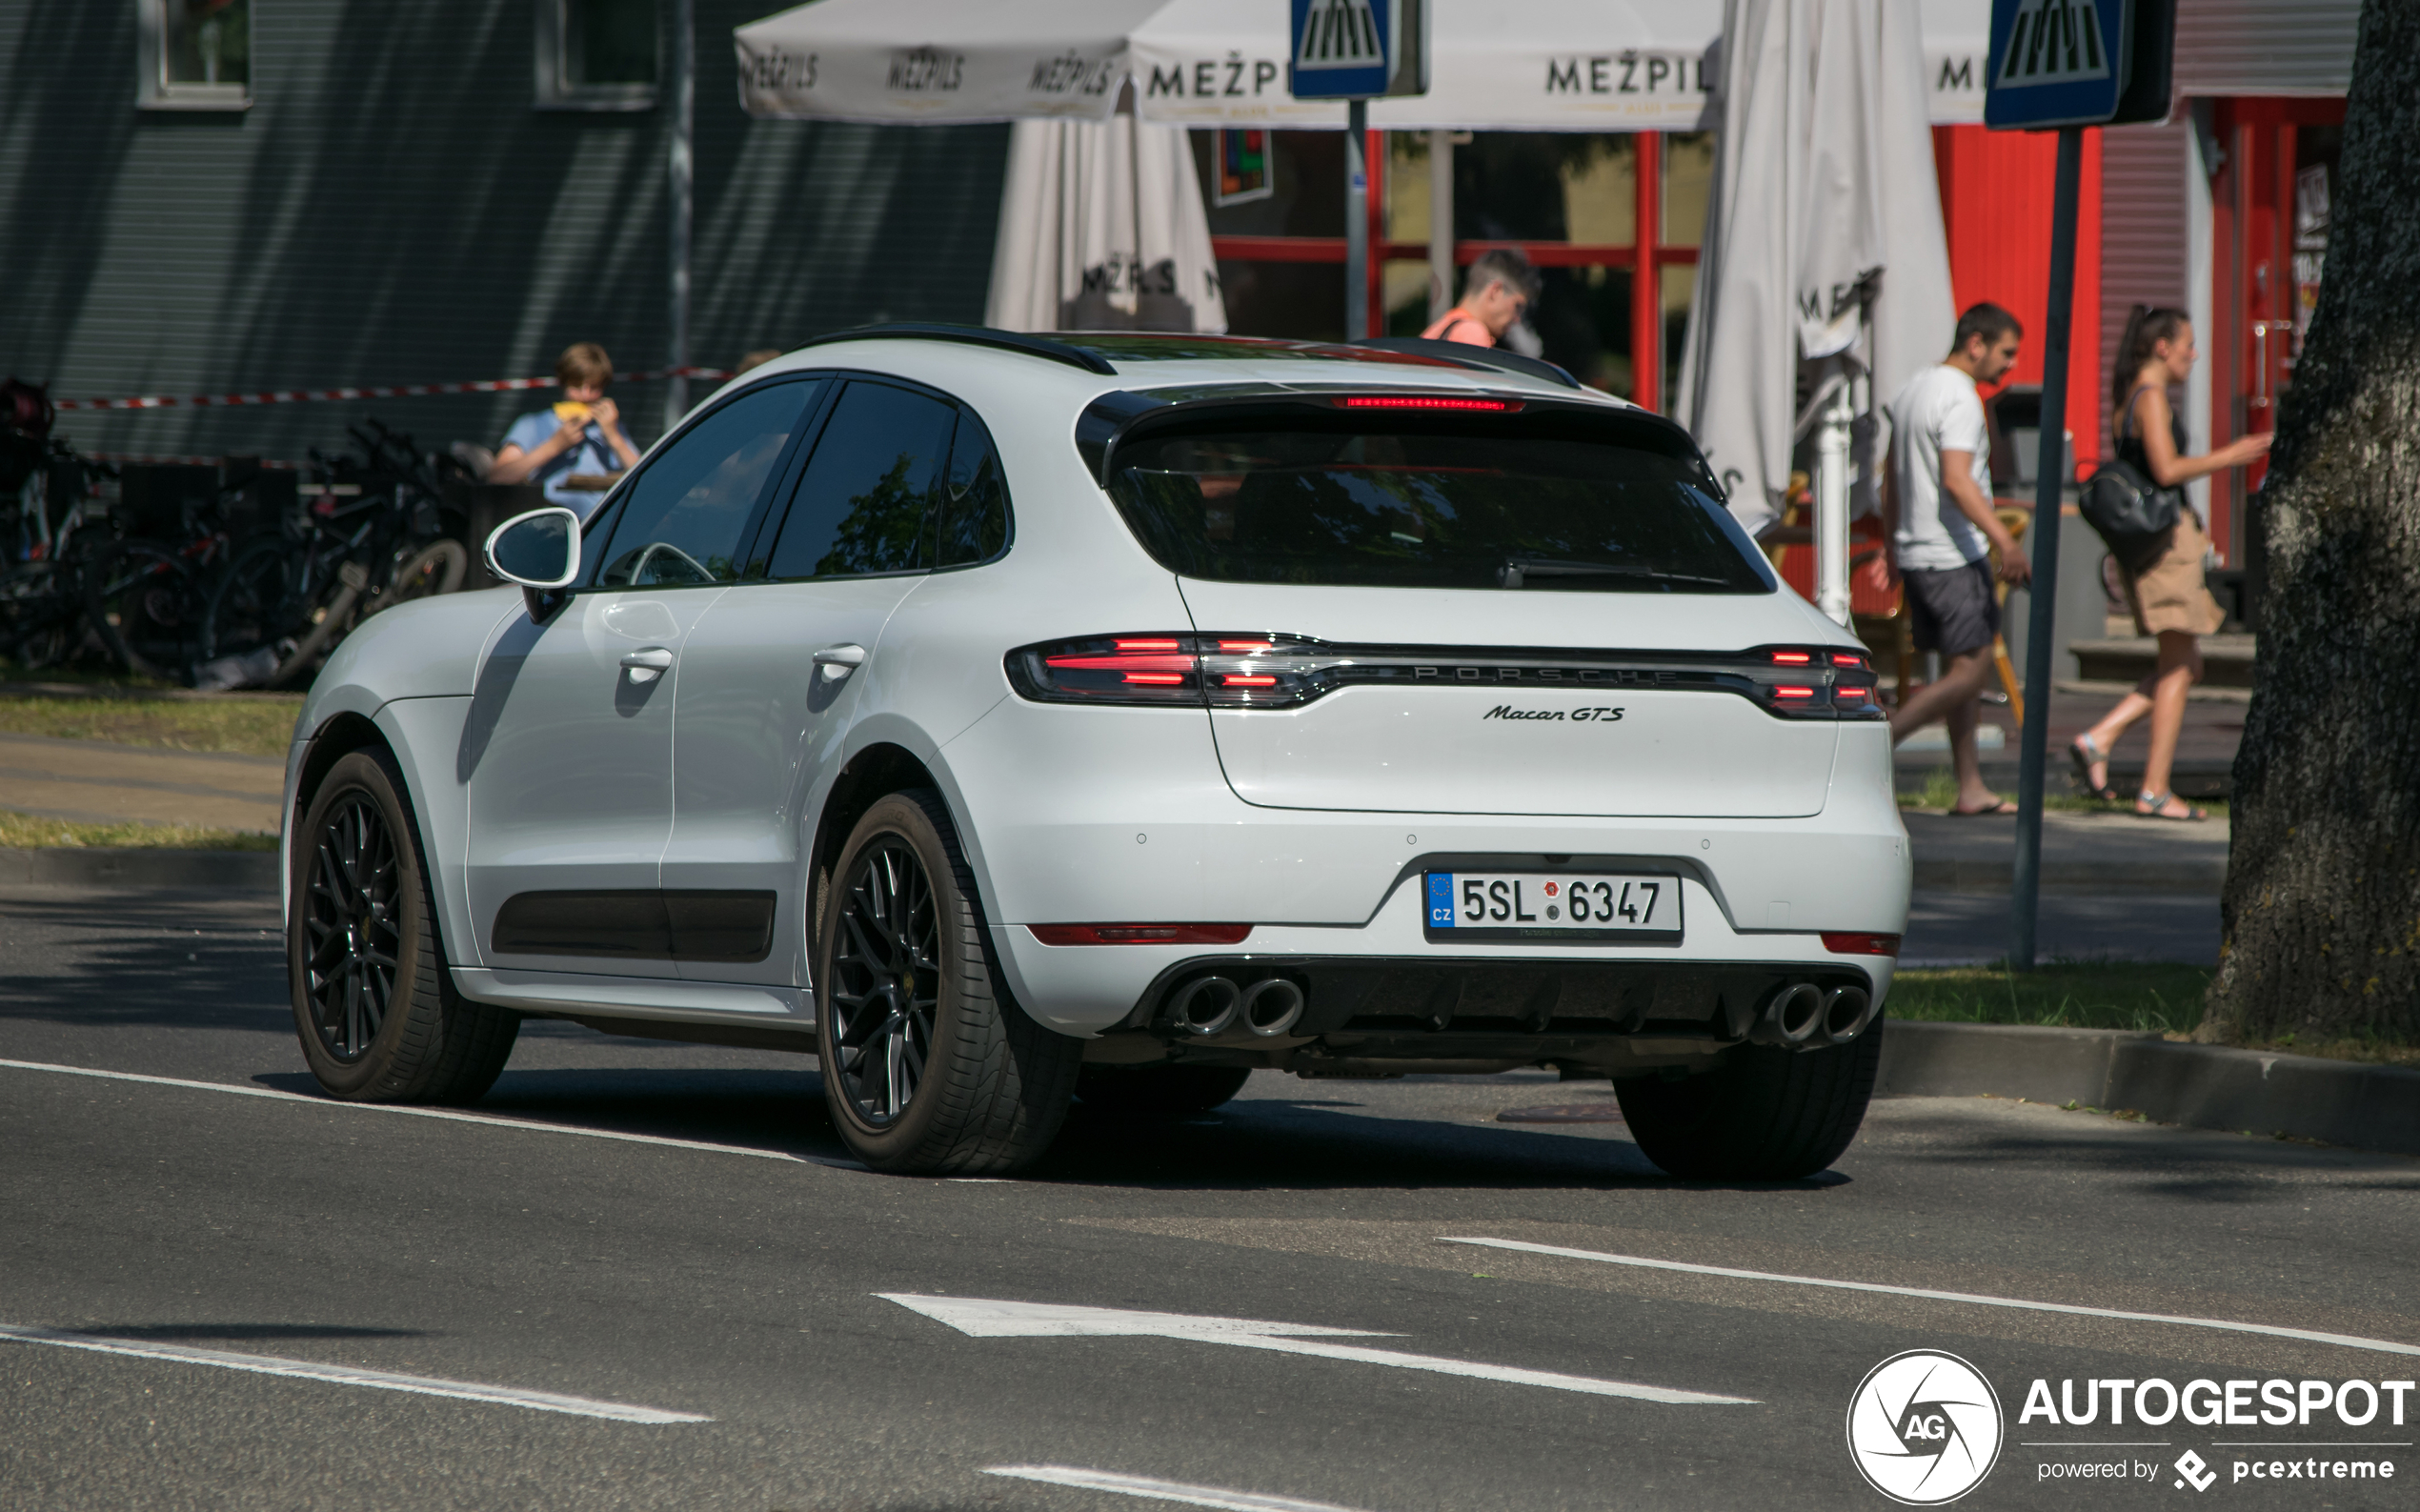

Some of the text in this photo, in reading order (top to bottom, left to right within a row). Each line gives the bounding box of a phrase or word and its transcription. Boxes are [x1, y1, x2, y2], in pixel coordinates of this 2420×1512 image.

[1414, 666, 1678, 684] PORSCHE
[1482, 705, 1626, 721] Macan GTS
[1462, 878, 1661, 924] 5SL 6347
[1432, 908, 1452, 921] CZ
